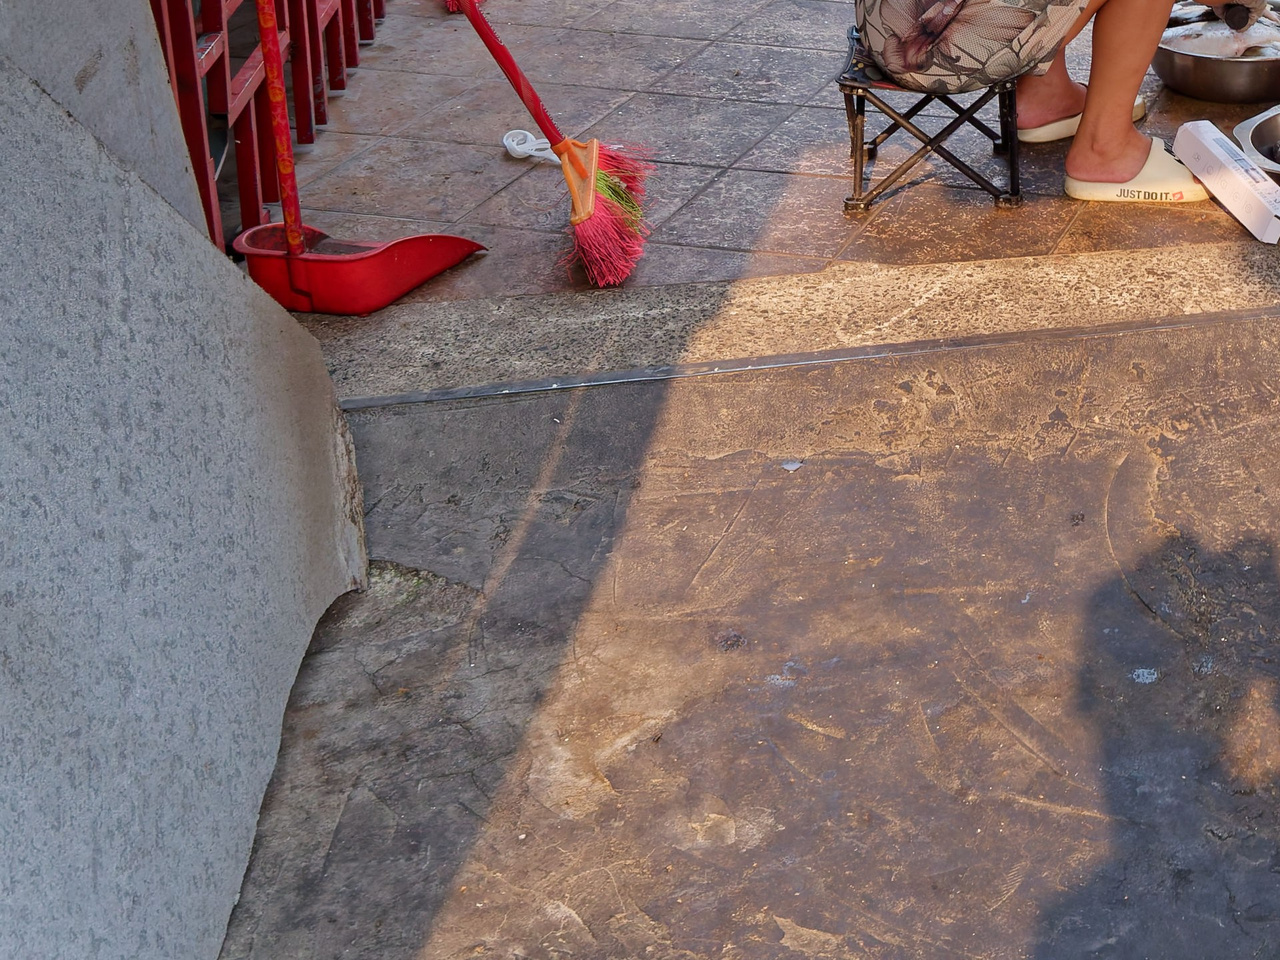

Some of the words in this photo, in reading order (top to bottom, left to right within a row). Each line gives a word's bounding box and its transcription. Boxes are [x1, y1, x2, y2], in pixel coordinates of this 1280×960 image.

[1116, 188, 1142, 199] JUST
[1143, 191, 1158, 200] DO
[1160, 192, 1172, 201] IT.
